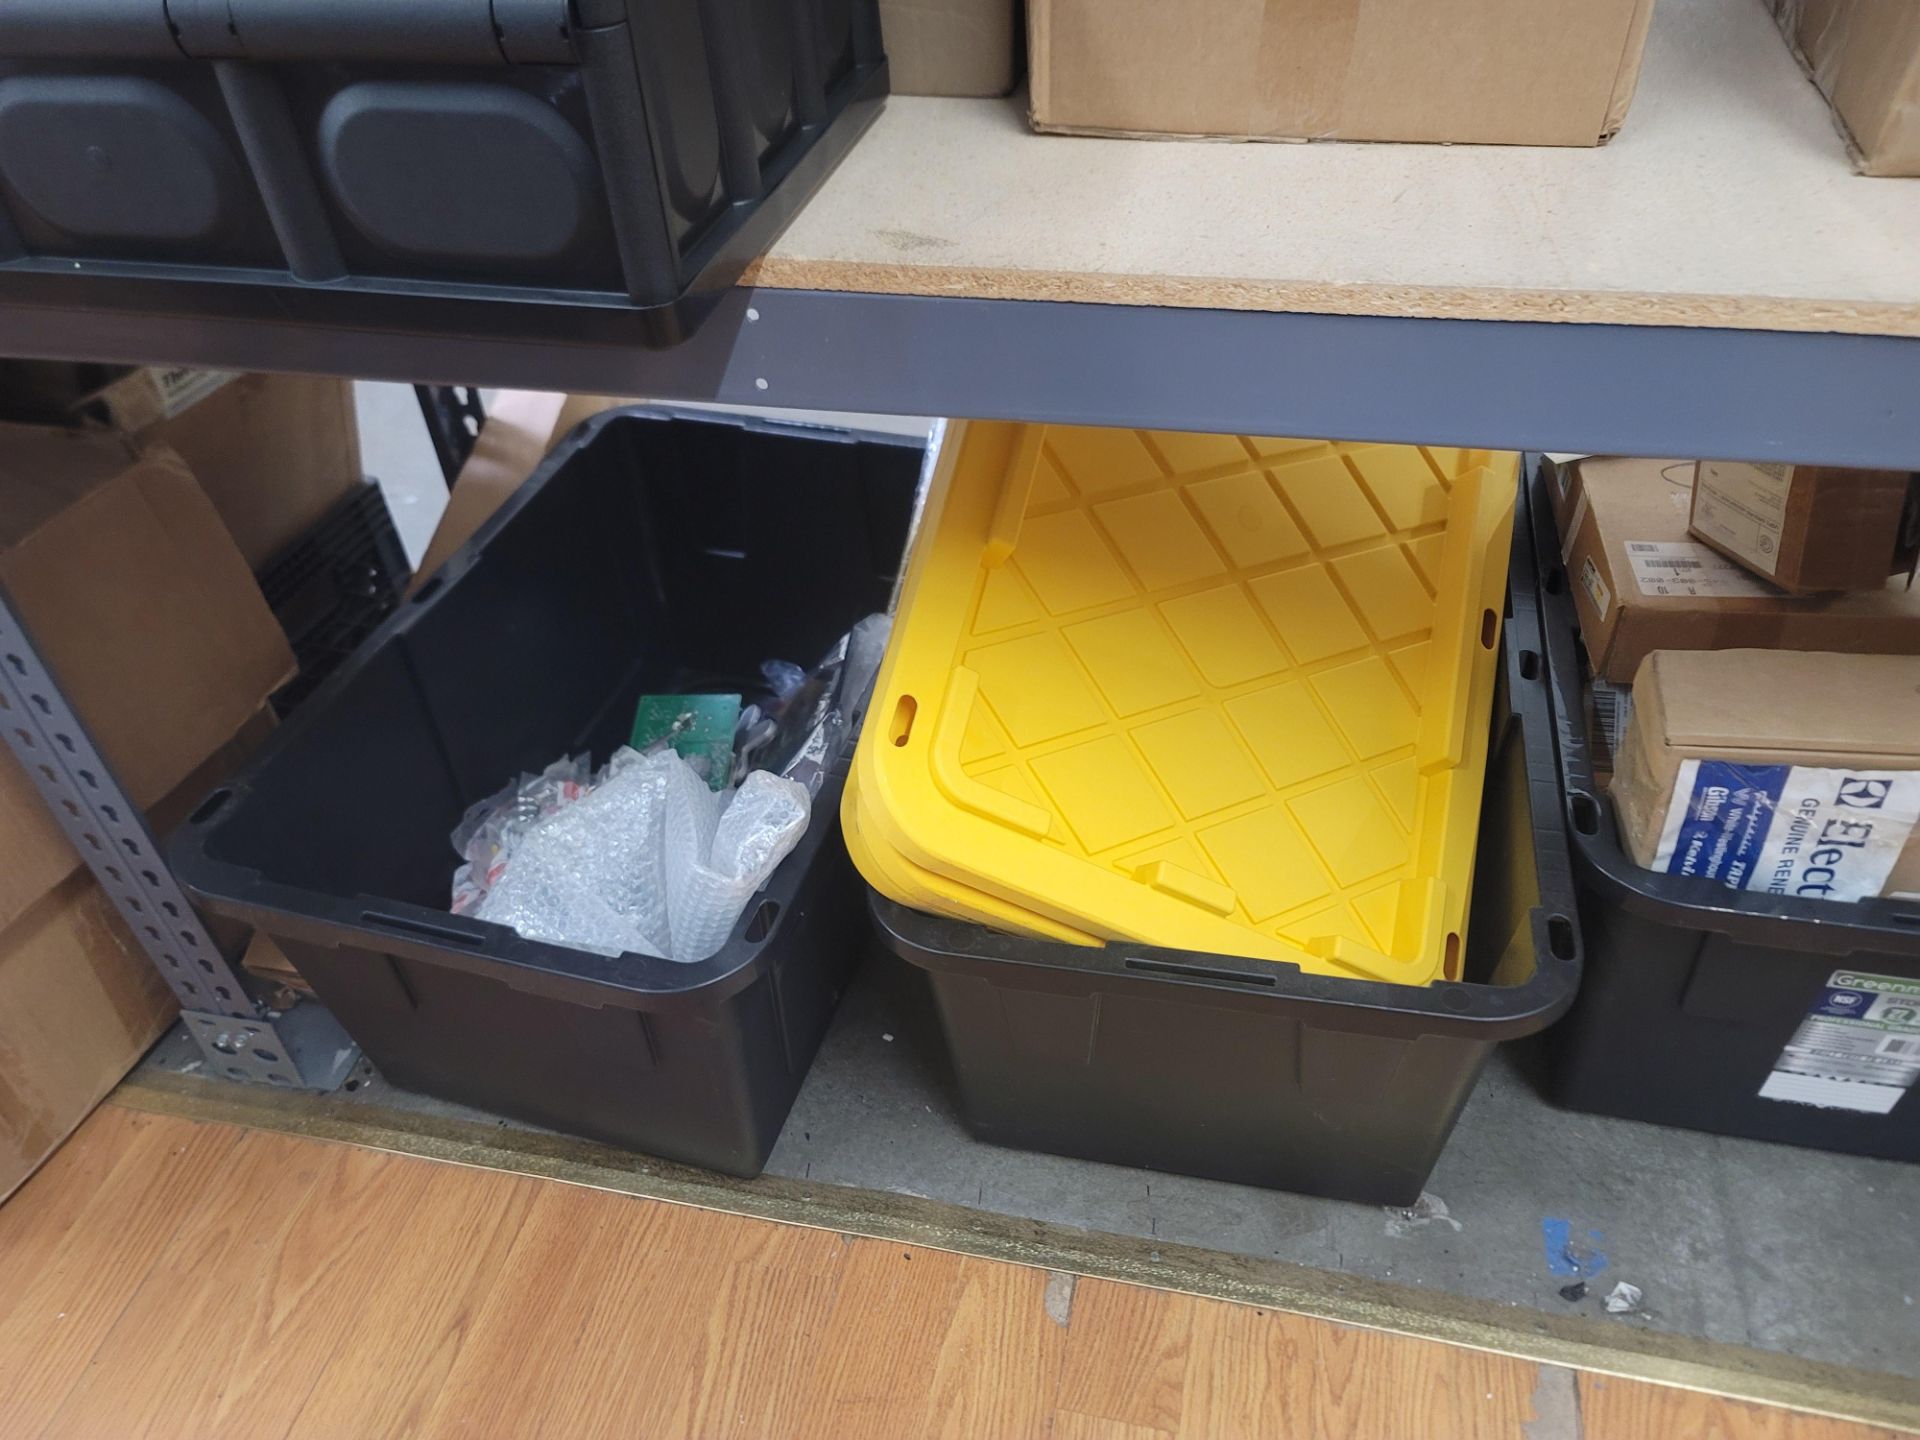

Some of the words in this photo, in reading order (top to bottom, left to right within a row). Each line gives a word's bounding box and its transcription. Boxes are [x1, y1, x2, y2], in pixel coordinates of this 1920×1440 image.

[1700, 786, 1729, 822] Gibson
[1782, 798, 1820, 854] GENUINE
[1796, 818, 1873, 899] Elect
